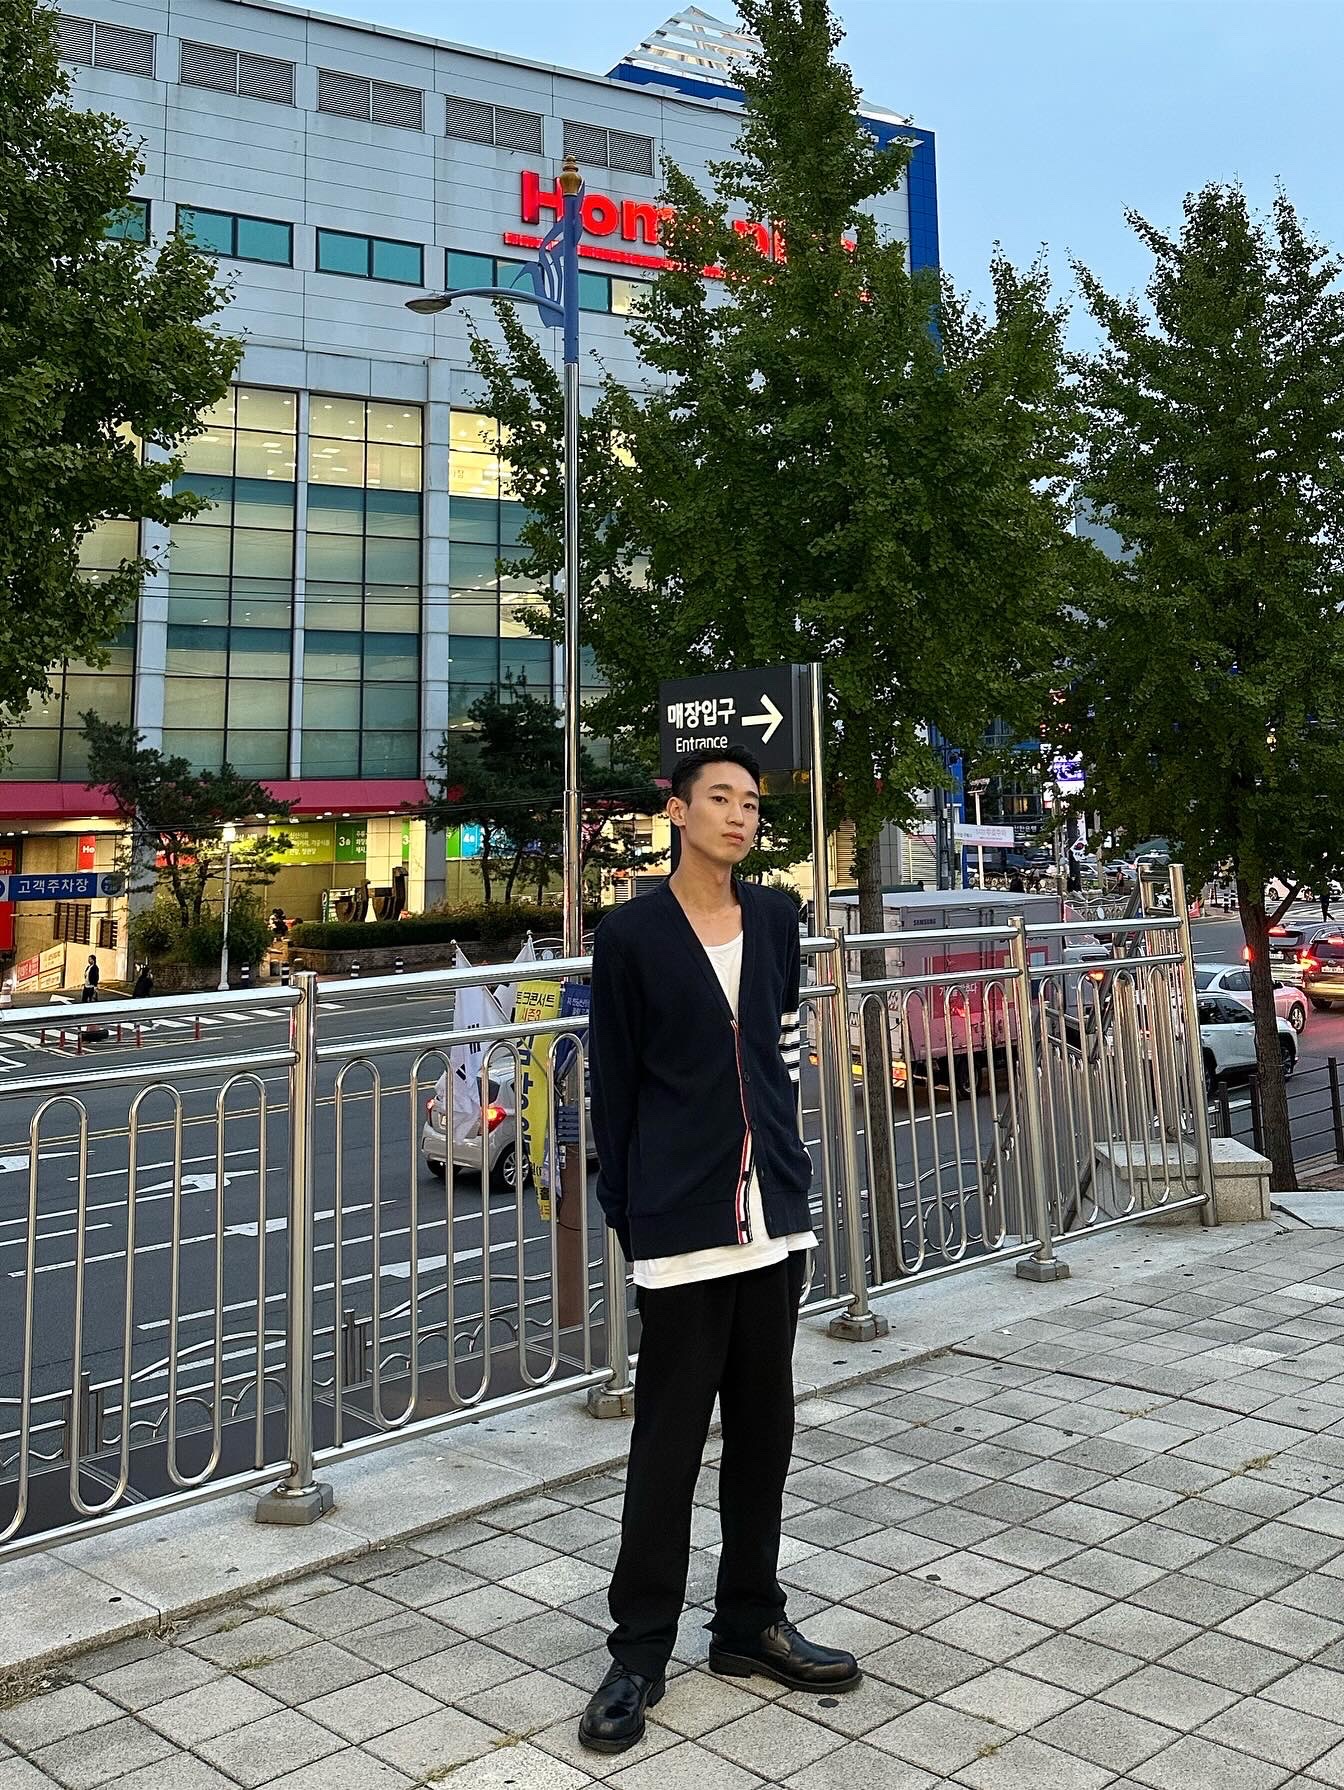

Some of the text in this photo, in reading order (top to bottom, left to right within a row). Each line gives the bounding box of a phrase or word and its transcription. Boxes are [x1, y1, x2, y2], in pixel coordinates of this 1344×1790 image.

[667, 697, 736, 729] 매장입구
[675, 735, 728, 753] Entrance
[17, 878, 88, 894] 고객주차장
[913, 918, 937, 927] SAMSUNG
